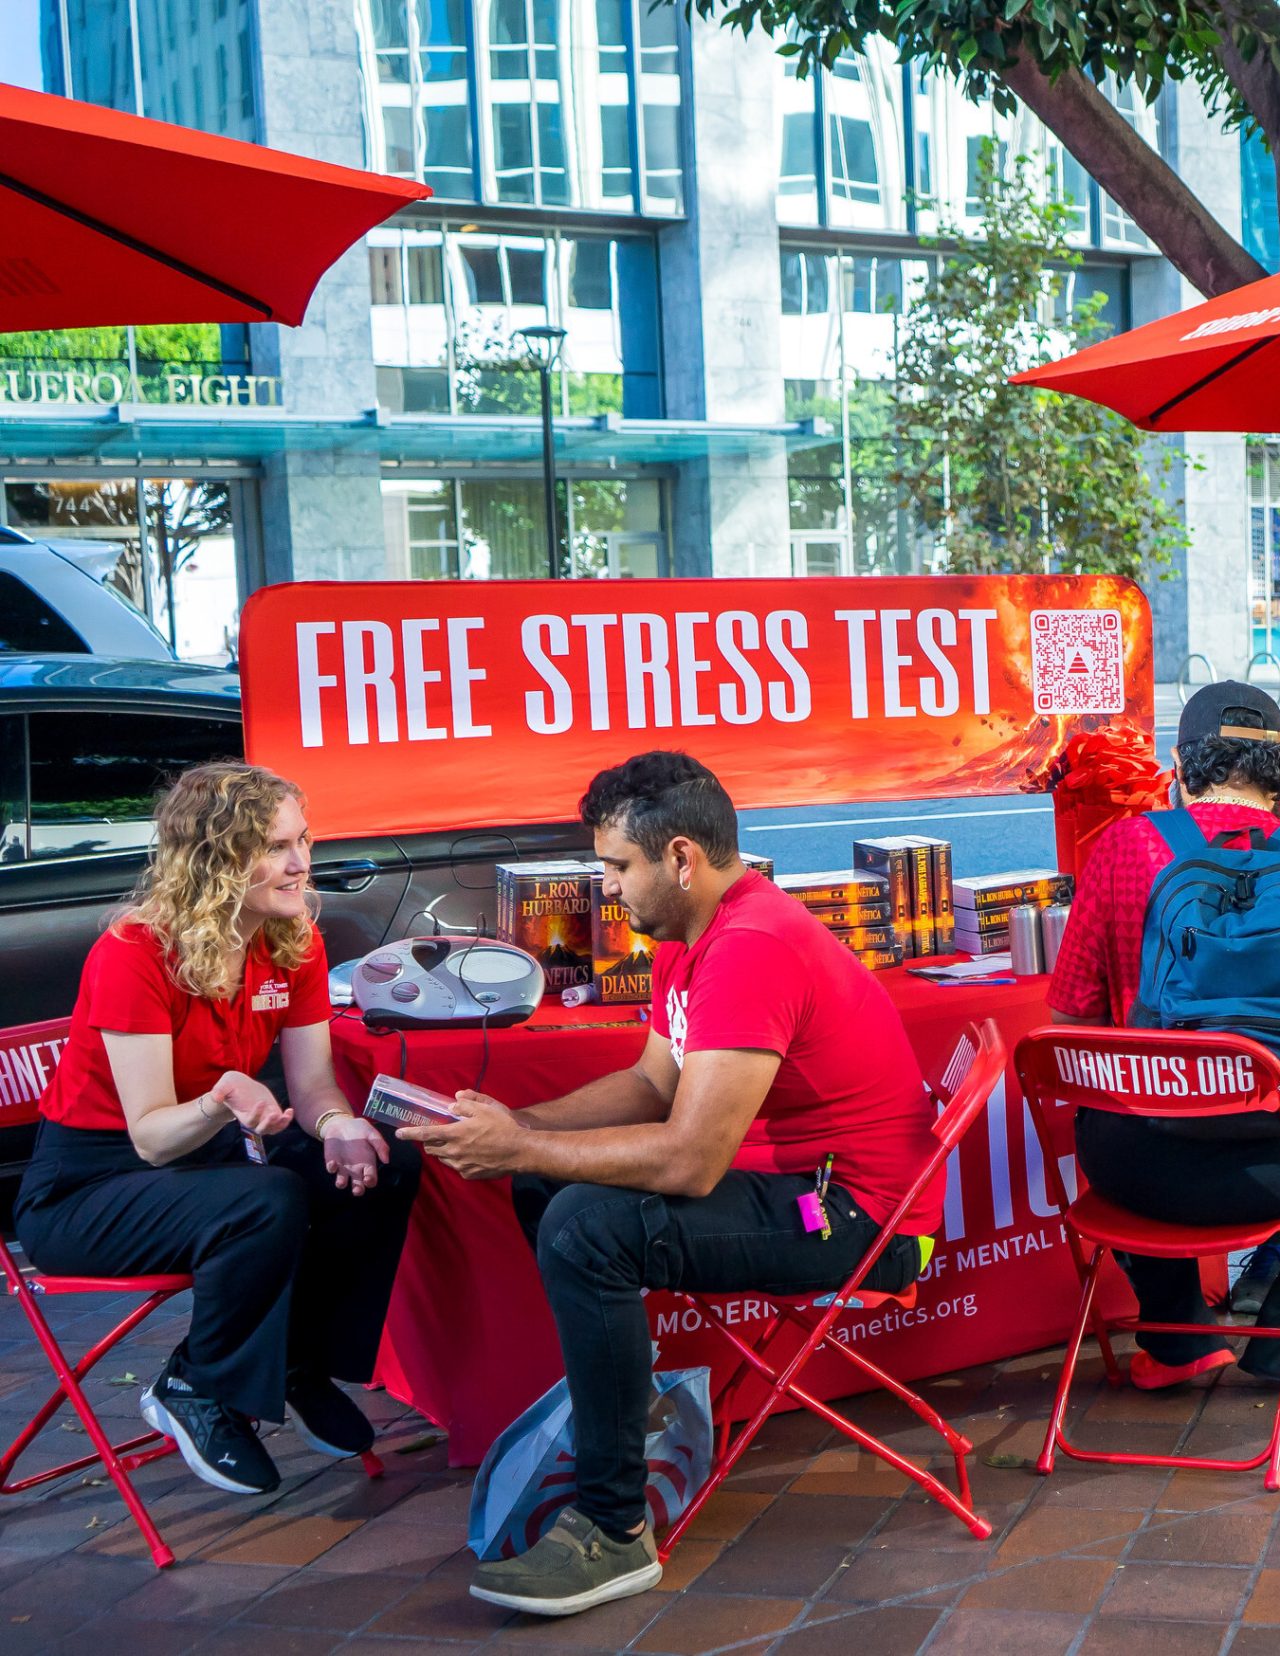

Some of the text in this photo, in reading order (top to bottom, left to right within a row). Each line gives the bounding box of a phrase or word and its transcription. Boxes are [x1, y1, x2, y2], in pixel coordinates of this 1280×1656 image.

[0, 370, 283, 406] UEROA EIGHT
[296, 608, 998, 748] FREE STRESS TEST
[522, 898, 591, 917] HUBBARD
[535, 881, 579, 899] L. RON
[545, 965, 589, 986] NETICS
[602, 973, 652, 995] DIANET
[1053, 1045, 1255, 1097] DIANETICS.ORG
[957, 1230, 1053, 1273] MENTAL
[815, 1294, 978, 1350] anetics.org
